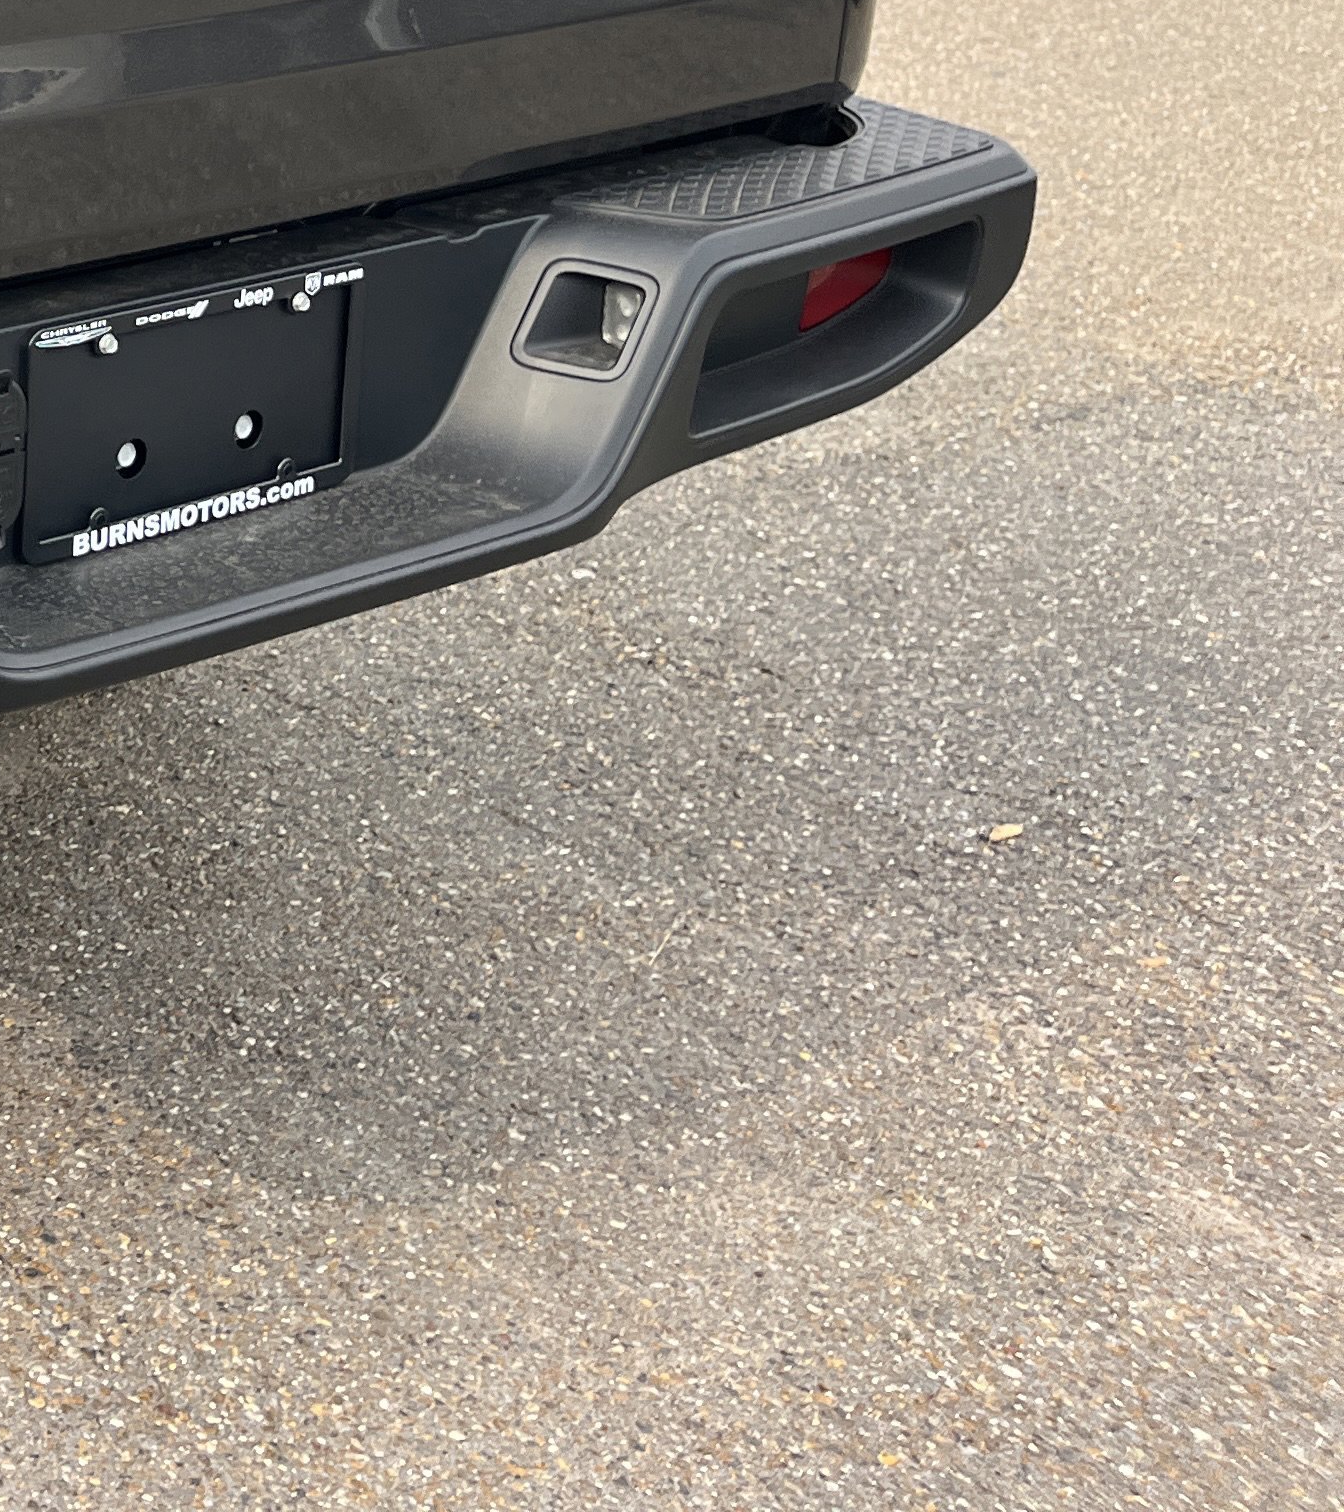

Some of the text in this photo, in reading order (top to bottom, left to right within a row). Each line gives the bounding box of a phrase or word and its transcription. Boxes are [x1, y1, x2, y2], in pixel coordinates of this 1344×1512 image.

[323, 268, 363, 287] RAM
[233, 287, 273, 309] Jeep
[40, 319, 107, 339] CHRYSLER
[72, 476, 314, 557] BURNSMOTORS.com
